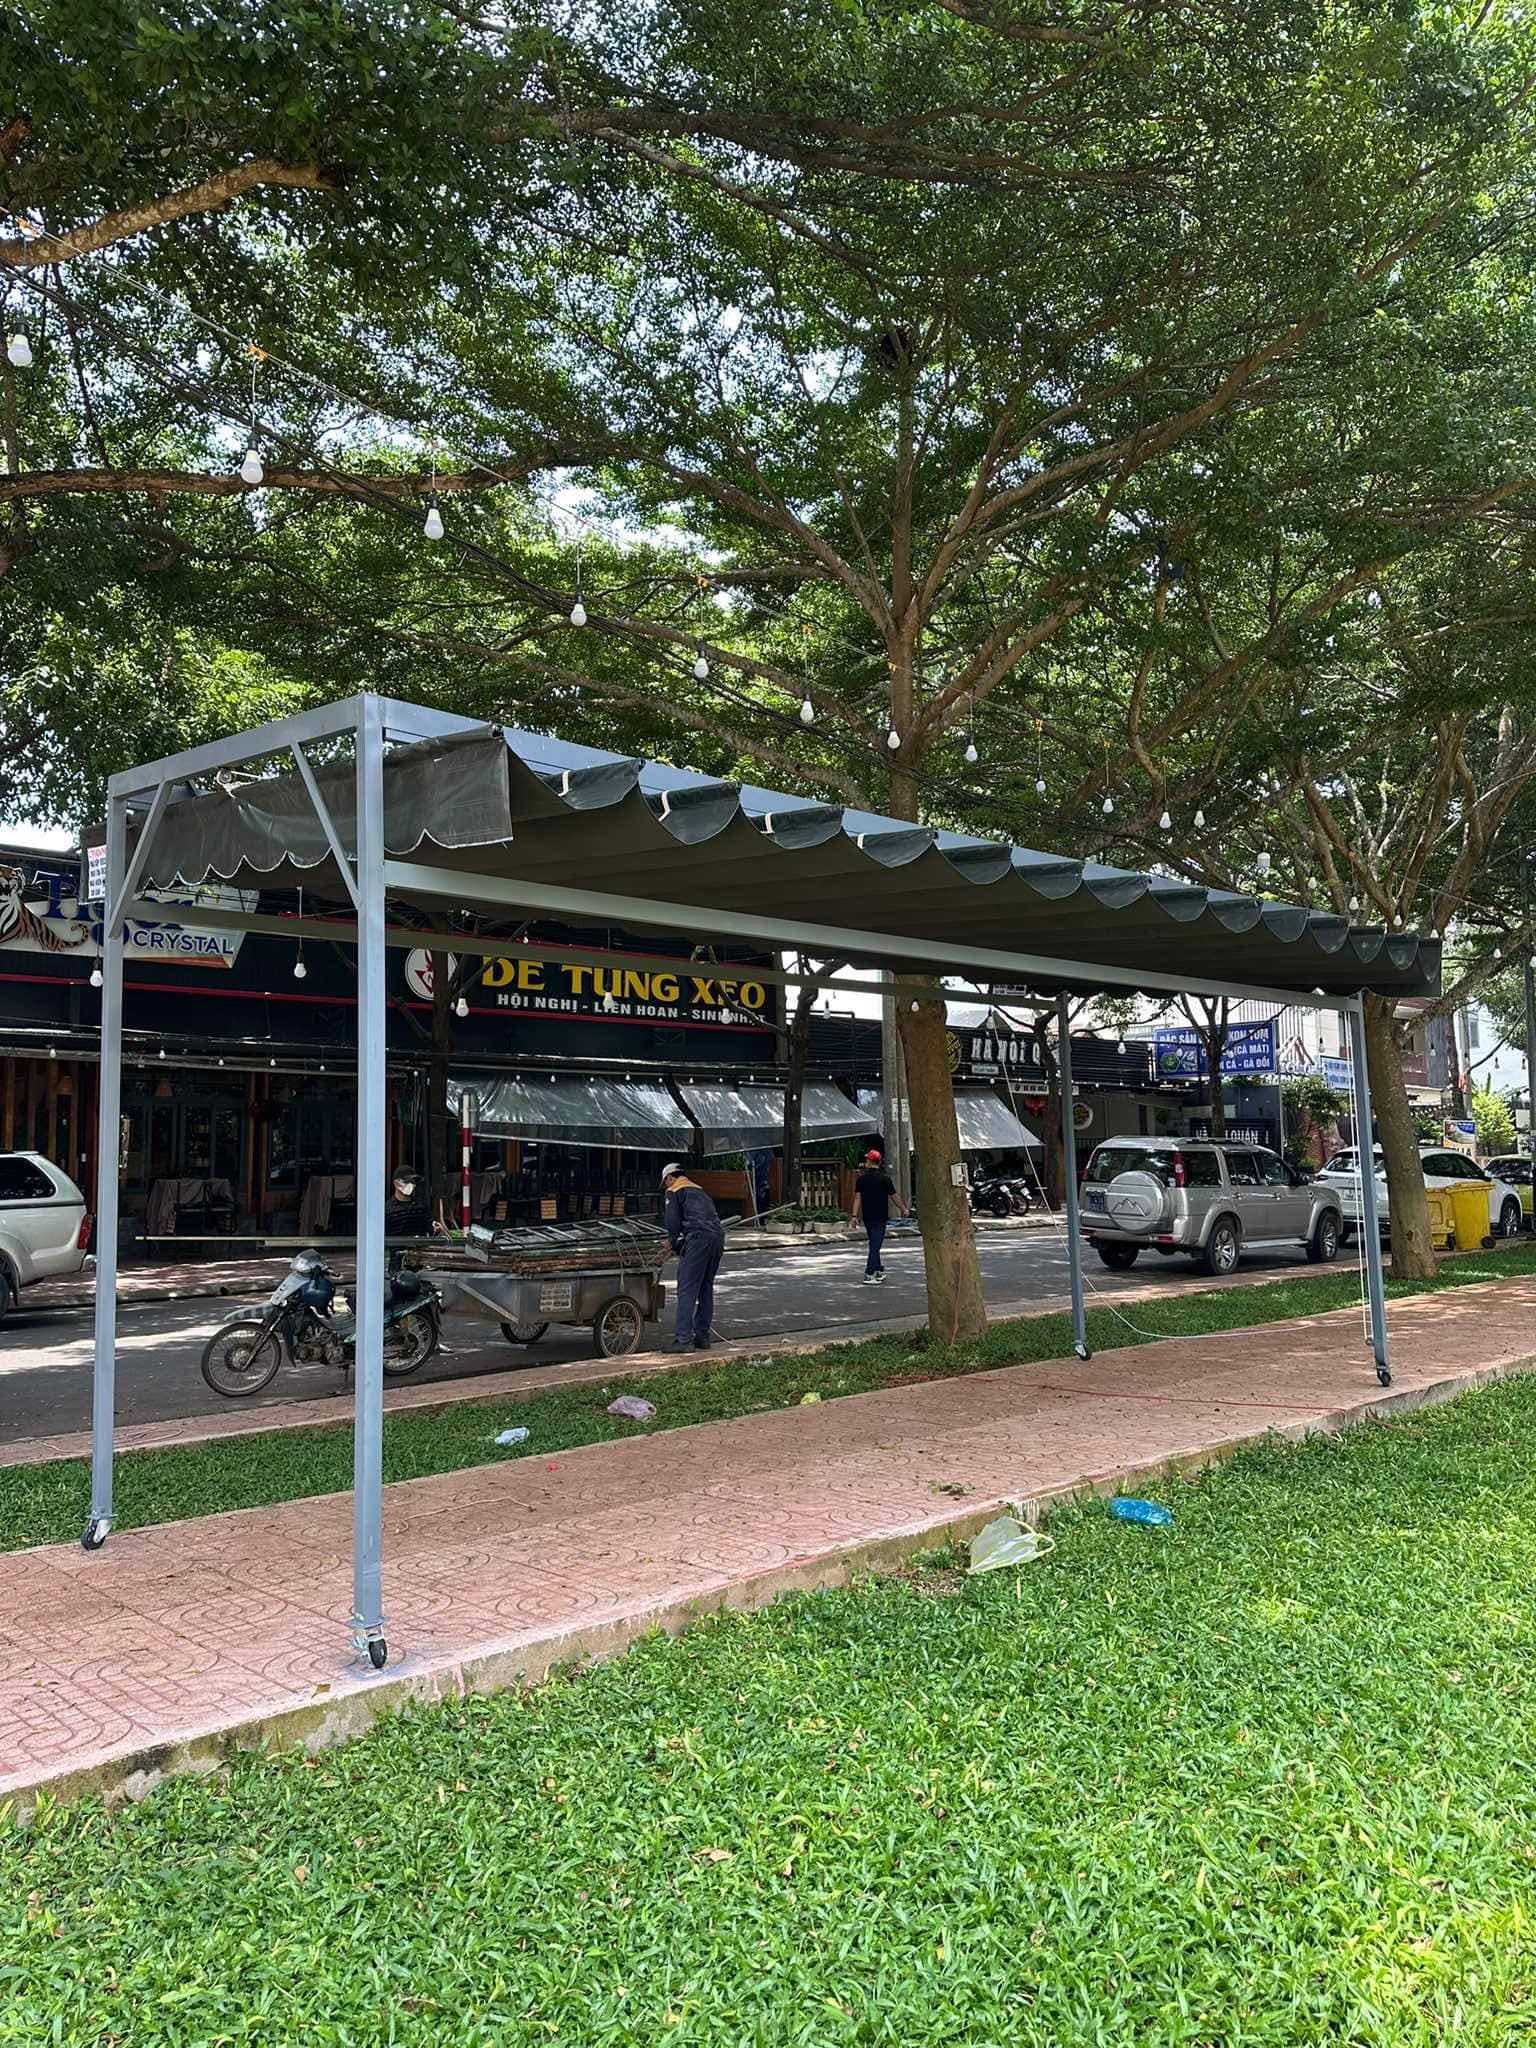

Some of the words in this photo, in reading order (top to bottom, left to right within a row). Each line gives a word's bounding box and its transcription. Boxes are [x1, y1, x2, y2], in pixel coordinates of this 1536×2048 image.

[133, 930, 234, 955] CRYSTAL
[497, 992, 529, 1009] HỘI
[535, 996, 578, 1013] NGHỊ
[637, 1004, 678, 1018] HOAN
[730, 1012, 767, 1026] NHT
